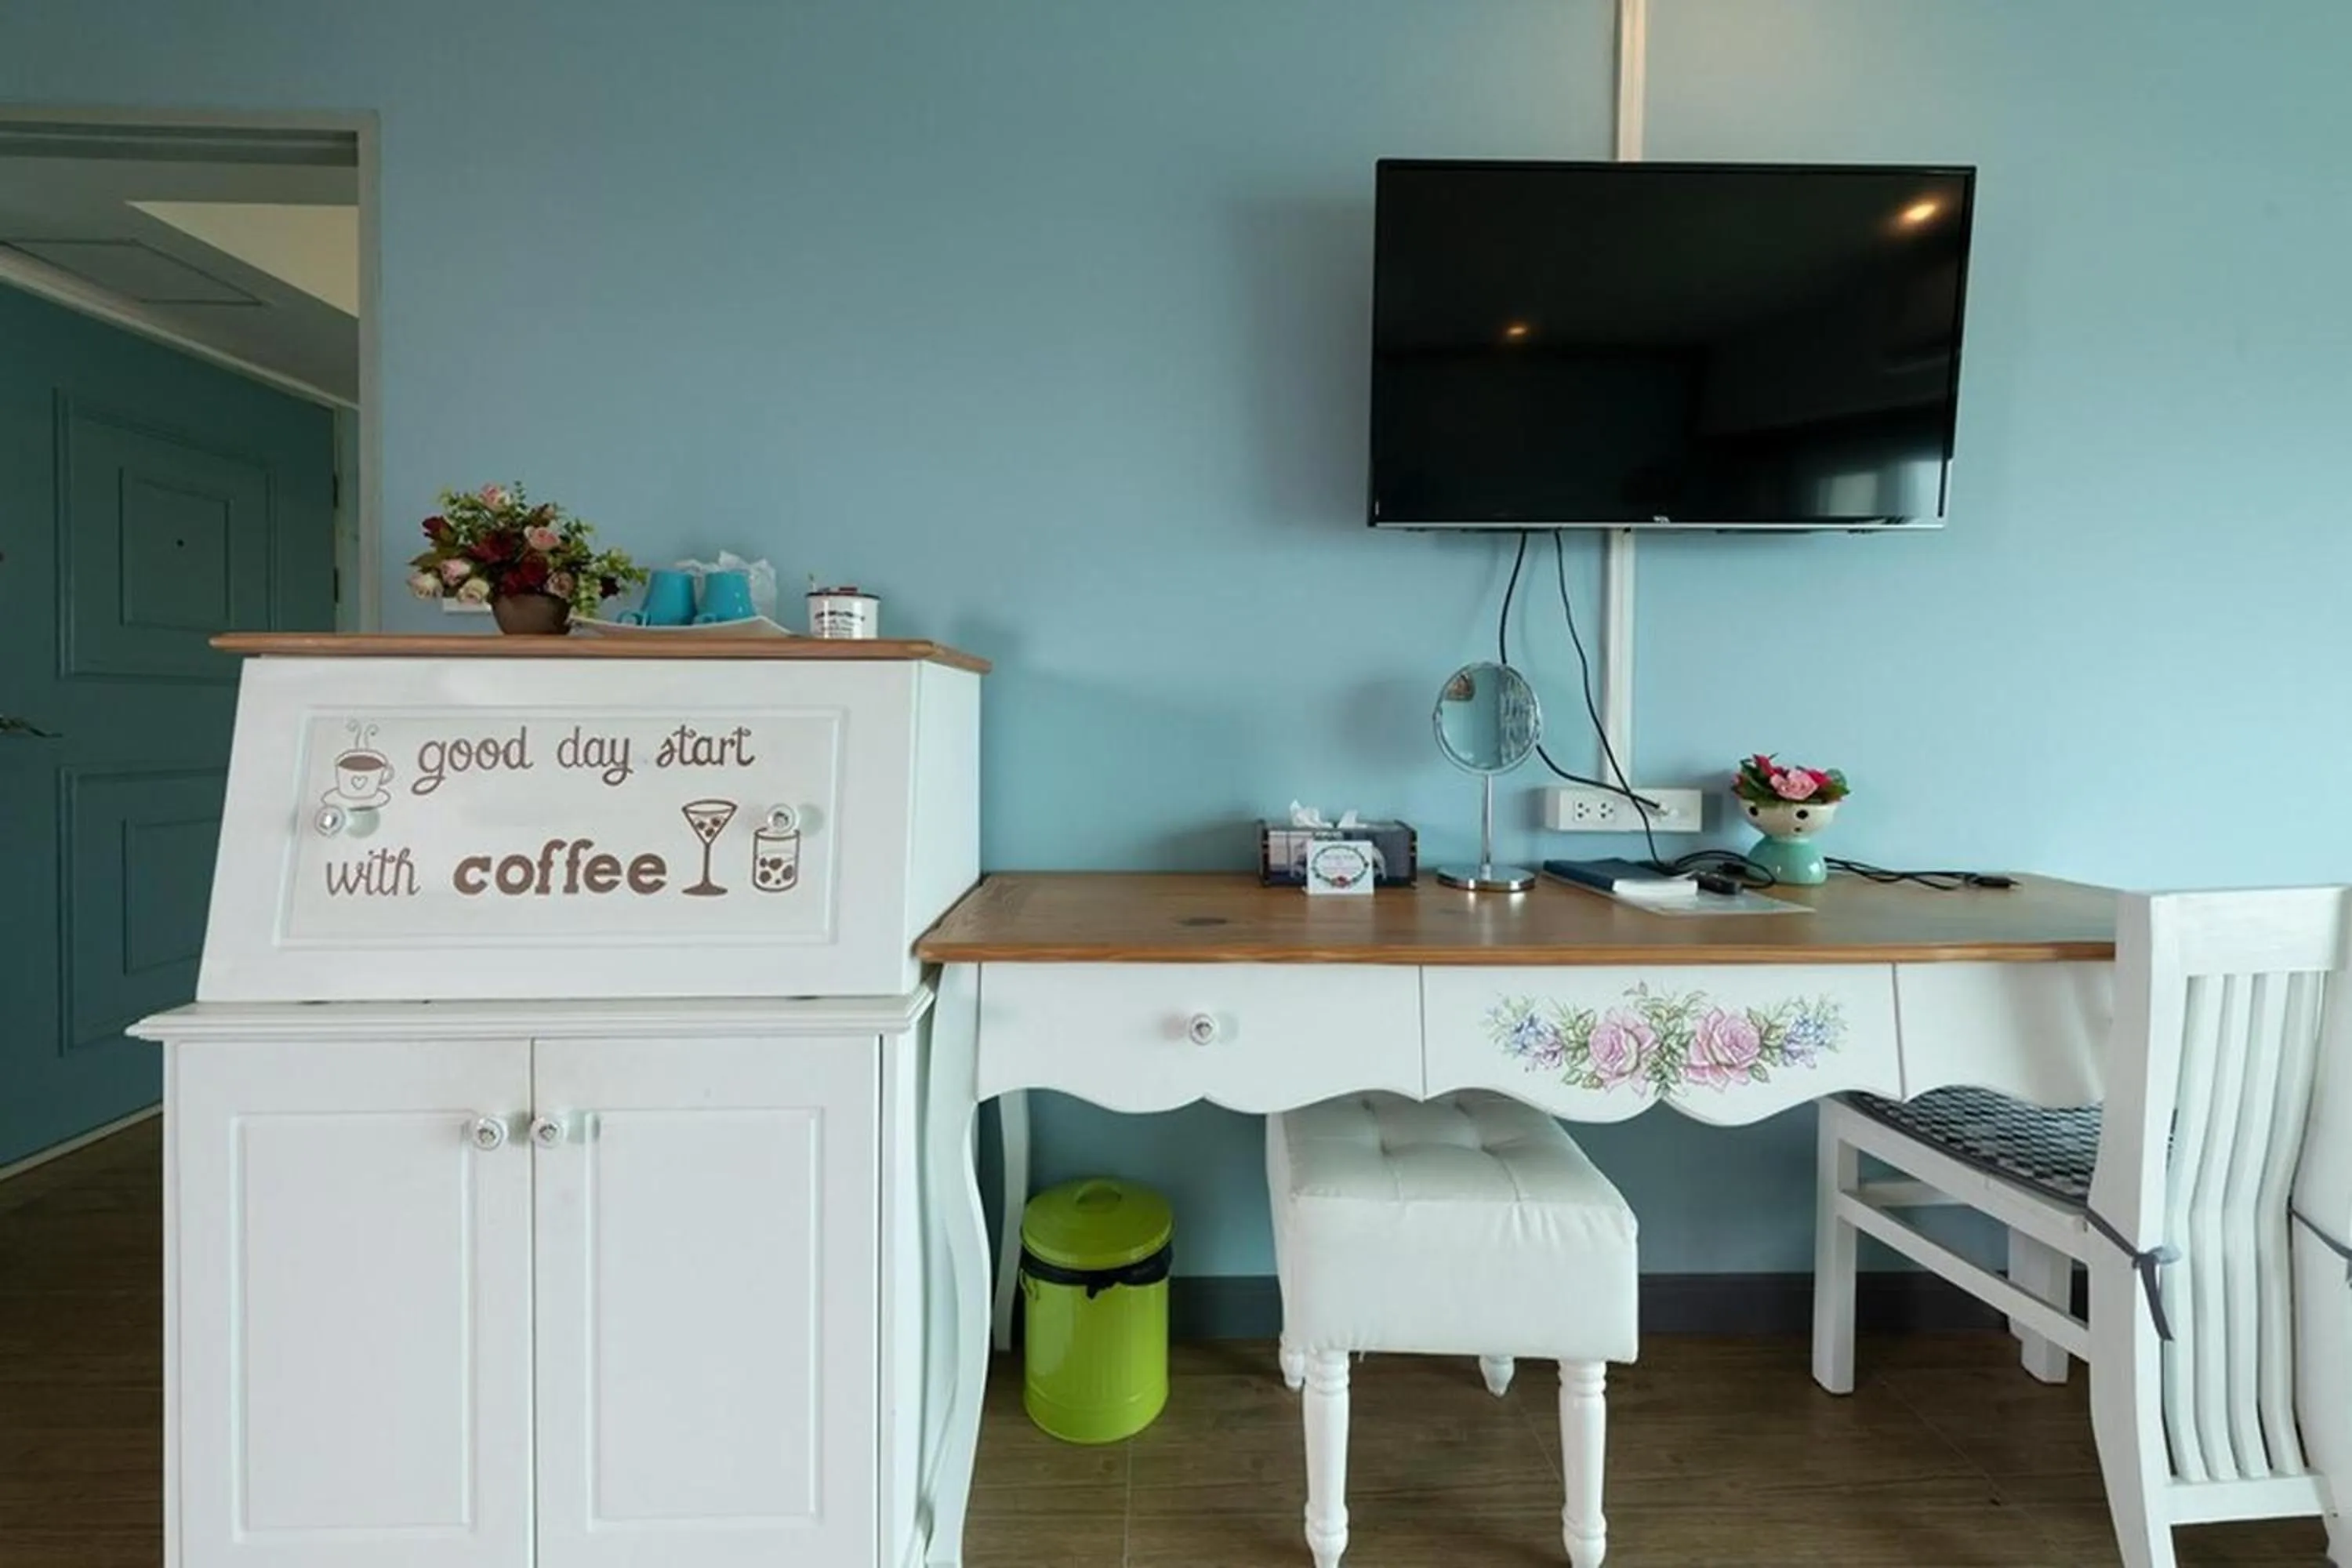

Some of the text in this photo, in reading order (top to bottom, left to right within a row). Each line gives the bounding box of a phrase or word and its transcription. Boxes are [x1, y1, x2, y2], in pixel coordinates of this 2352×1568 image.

[411, 724, 756, 796] good day start
[325, 838, 667, 896] with coffee
